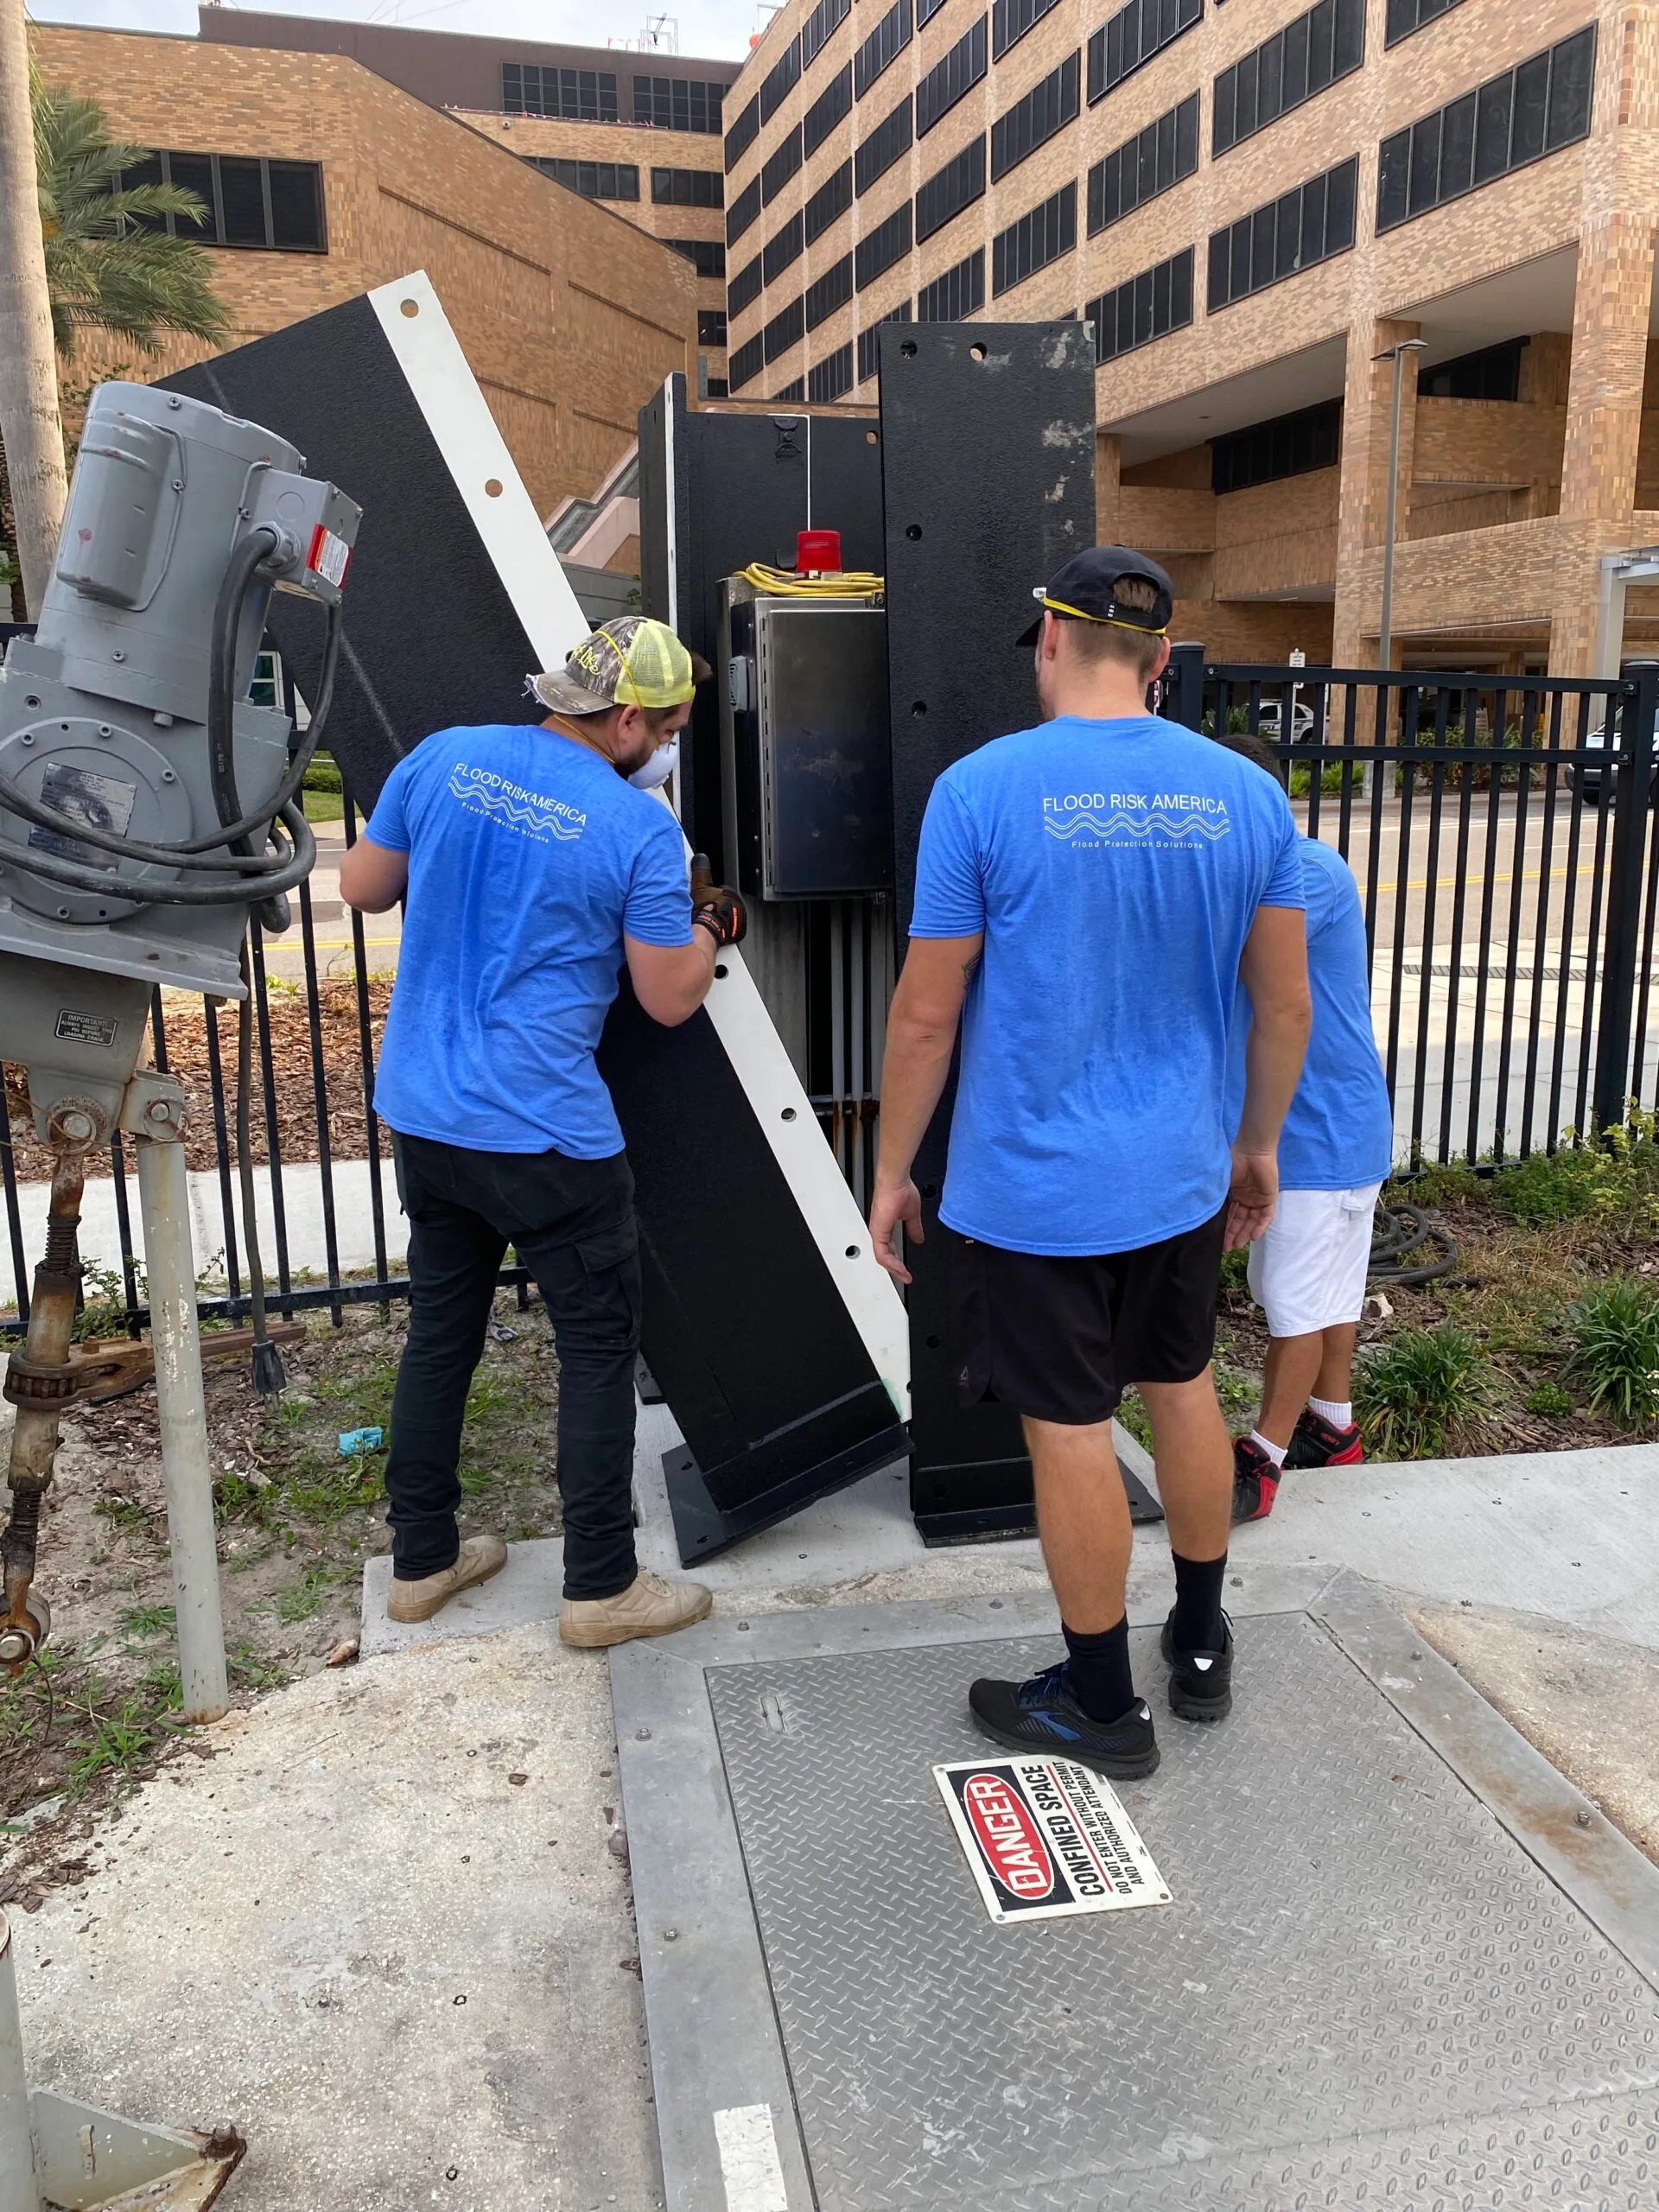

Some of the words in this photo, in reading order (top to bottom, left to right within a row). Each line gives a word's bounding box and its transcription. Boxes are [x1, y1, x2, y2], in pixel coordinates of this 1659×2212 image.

[454, 762, 502, 788] FLOOD
[1043, 792, 1106, 813] FLOOD
[1109, 793, 1147, 810] RISK
[1151, 794, 1228, 815] AMERICA
[1071, 840, 1100, 849] Flood
[1104, 840, 1153, 849] Protection
[1155, 840, 1203, 849] Solutions
[1020, 1764, 1064, 1811] SPACE
[1052, 1761, 1076, 1791] PERMIT
[1068, 1765, 1103, 1810] ATTENDANT
[1071, 1790, 1097, 1829] WITHOUT
[968, 1780, 1049, 1891] DANGER
[1090, 1828, 1115, 1859] ENTER
[1095, 1810, 1135, 1864] AUTHORIZED
[1046, 1815, 1106, 1897] CONFINED
[1103, 1859, 1124, 1878] NOT
[1113, 1881, 1133, 1894] DO
[1123, 1865, 1145, 1885] AND
